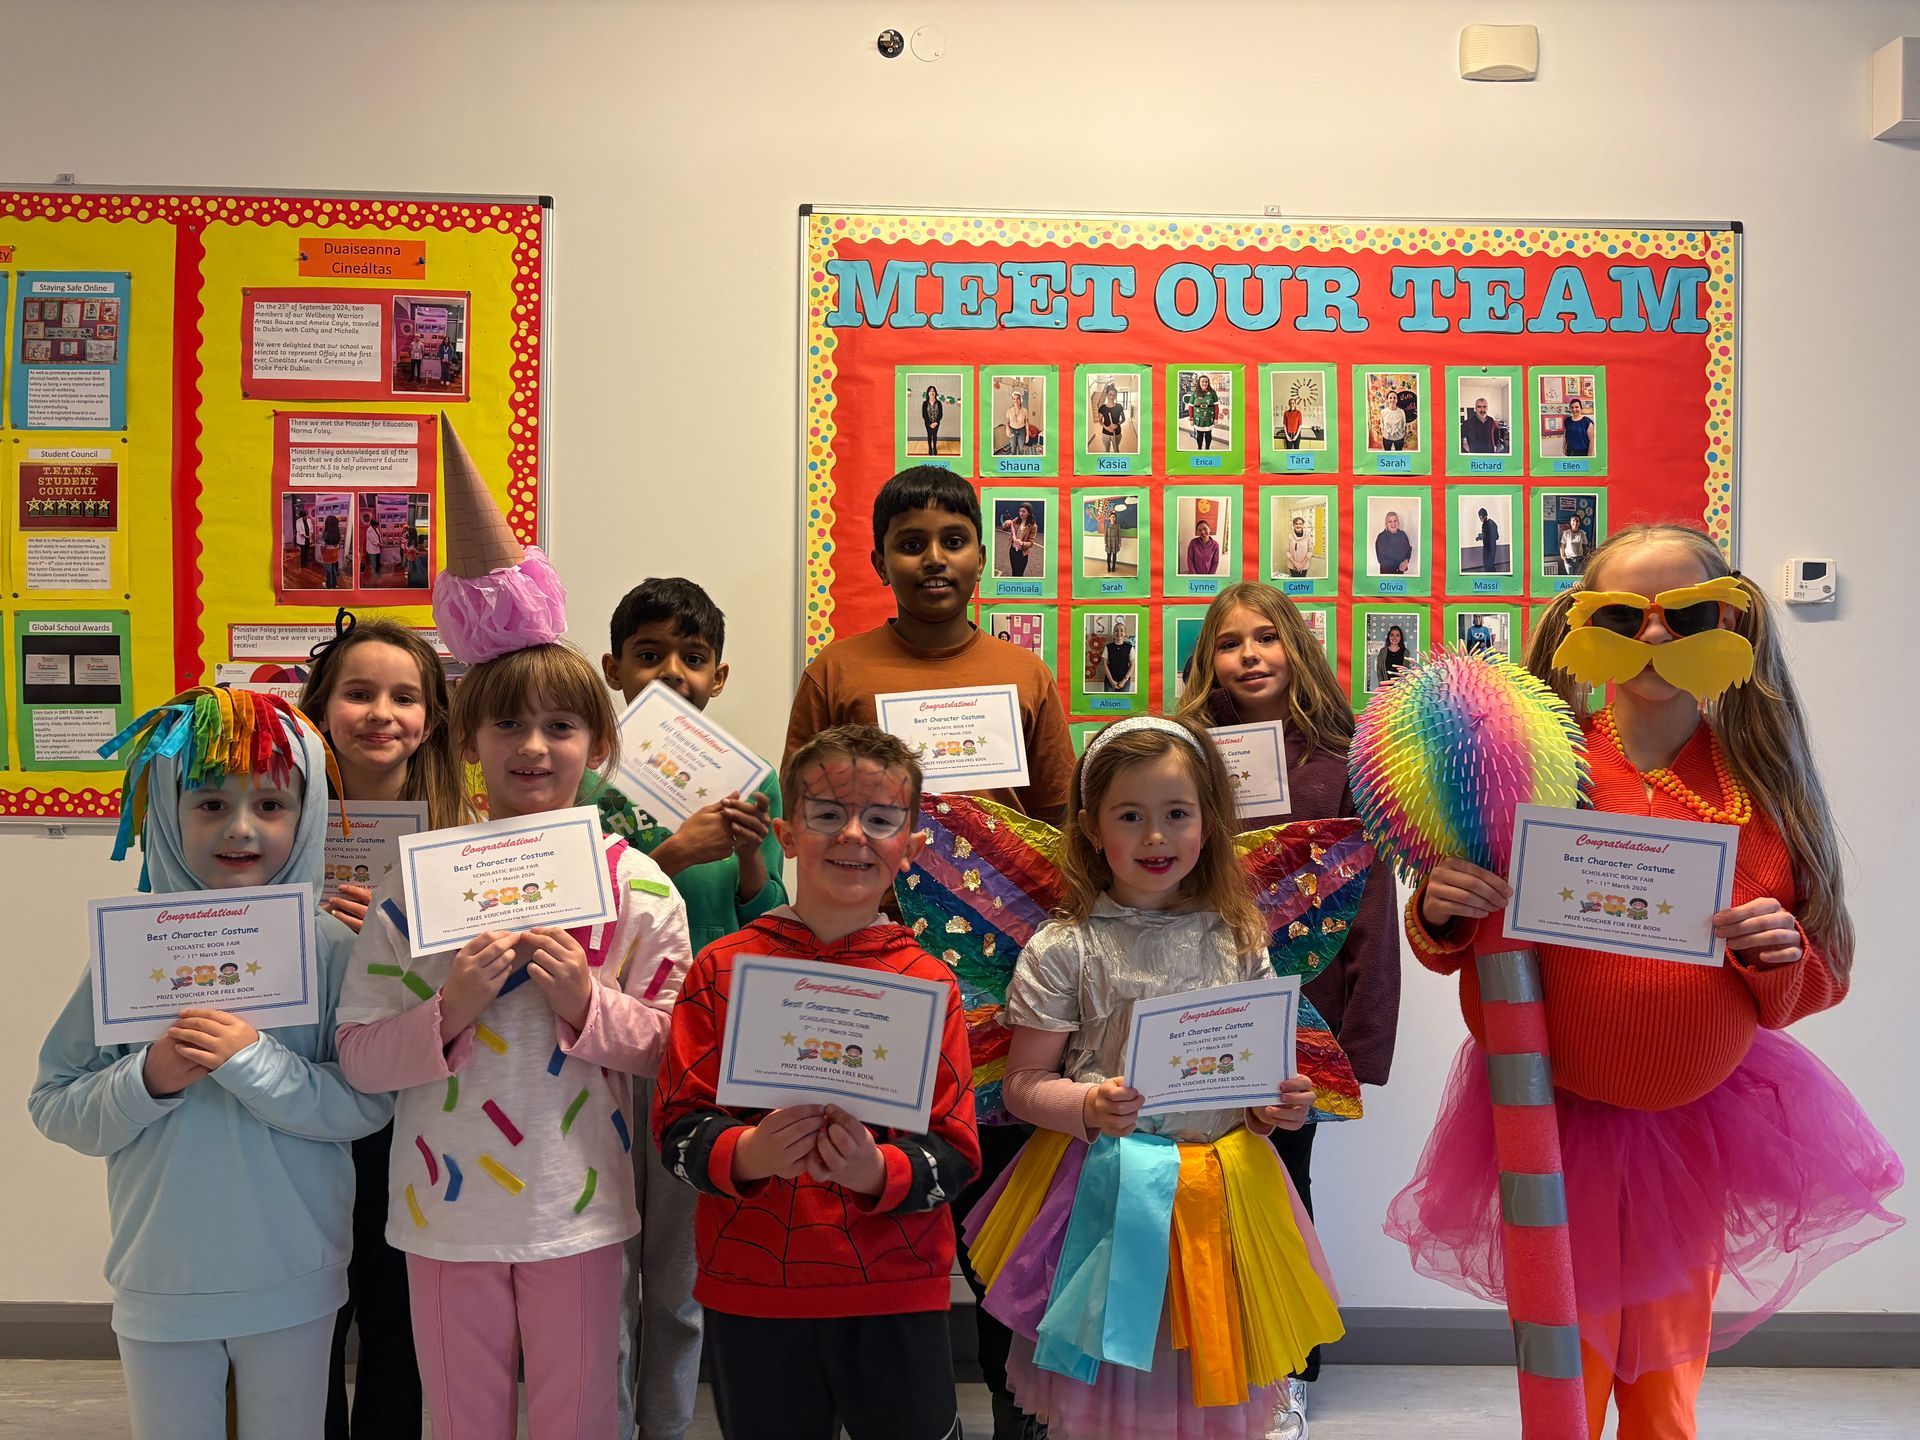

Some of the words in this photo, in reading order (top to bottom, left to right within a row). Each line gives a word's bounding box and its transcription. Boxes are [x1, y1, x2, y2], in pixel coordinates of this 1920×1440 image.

[324, 242, 400, 256] Duaiseanna
[332, 262, 392, 275] Cineáltas
[40, 284, 65, 292] Staying
[84, 284, 108, 292] Online
[825, 260, 1138, 332] MEET
[1154, 261, 1370, 333] OUR
[1391, 265, 1711, 335] TEAM
[336, 449, 380, 457] acknowledged
[391, 449, 397, 457] of
[1000, 460, 1040, 471] Shauna
[1099, 458, 1128, 470] Kasia
[1196, 458, 1213, 466] Erica
[1290, 456, 1310, 466] Tara
[1380, 458, 1406, 468] Sarah
[1470, 461, 1502, 471] Richard
[1562, 462, 1581, 470] Ellen
[42, 467, 94, 475] T.E.T.N.S.
[292, 464, 319, 472] Together
[38, 477, 98, 486] STUDENT
[39, 487, 96, 496] COUNCIL
[998, 584, 1039, 594] Fionnuala
[1102, 583, 1123, 591] Sarah
[1190, 582, 1216, 593] Lynne
[1288, 582, 1310, 593] Cathy
[1380, 582, 1404, 591] Olivia
[1474, 581, 1498, 590] Massi
[920, 699, 978, 712] Congratulations!
[1100, 700, 1121, 709] Alison
[462, 832, 544, 857] Congratulations!
[1576, 834, 1670, 854] Congratulations!
[454, 864, 472, 873] Best
[476, 857, 518, 869] Character
[521, 850, 555, 861] Costume
[1564, 853, 1584, 864] Best
[1588, 856, 1633, 869] Character
[1636, 863, 1676, 875] Costume
[1582, 869, 1620, 879] SCHOLASTIC
[1612, 882, 1630, 890] March
[157, 904, 250, 924] Congratulations!
[1582, 916, 1612, 926] VOUCHER
[1613, 920, 1626, 928] FOR
[1627, 922, 1642, 930] FREE
[1643, 924, 1662, 932] BOOK
[147, 933, 168, 942] Best
[172, 930, 218, 940] Character
[222, 927, 259, 936] Costume
[167, 944, 205, 952] SCHOLASTIC
[175, 991, 205, 999] VOUCHER
[1180, 1002, 1250, 1024] Congratulations!
[1170, 1032, 1185, 1040] Best
[1188, 1026, 1223, 1036] Character
[1225, 1022, 1254, 1030] Costume
